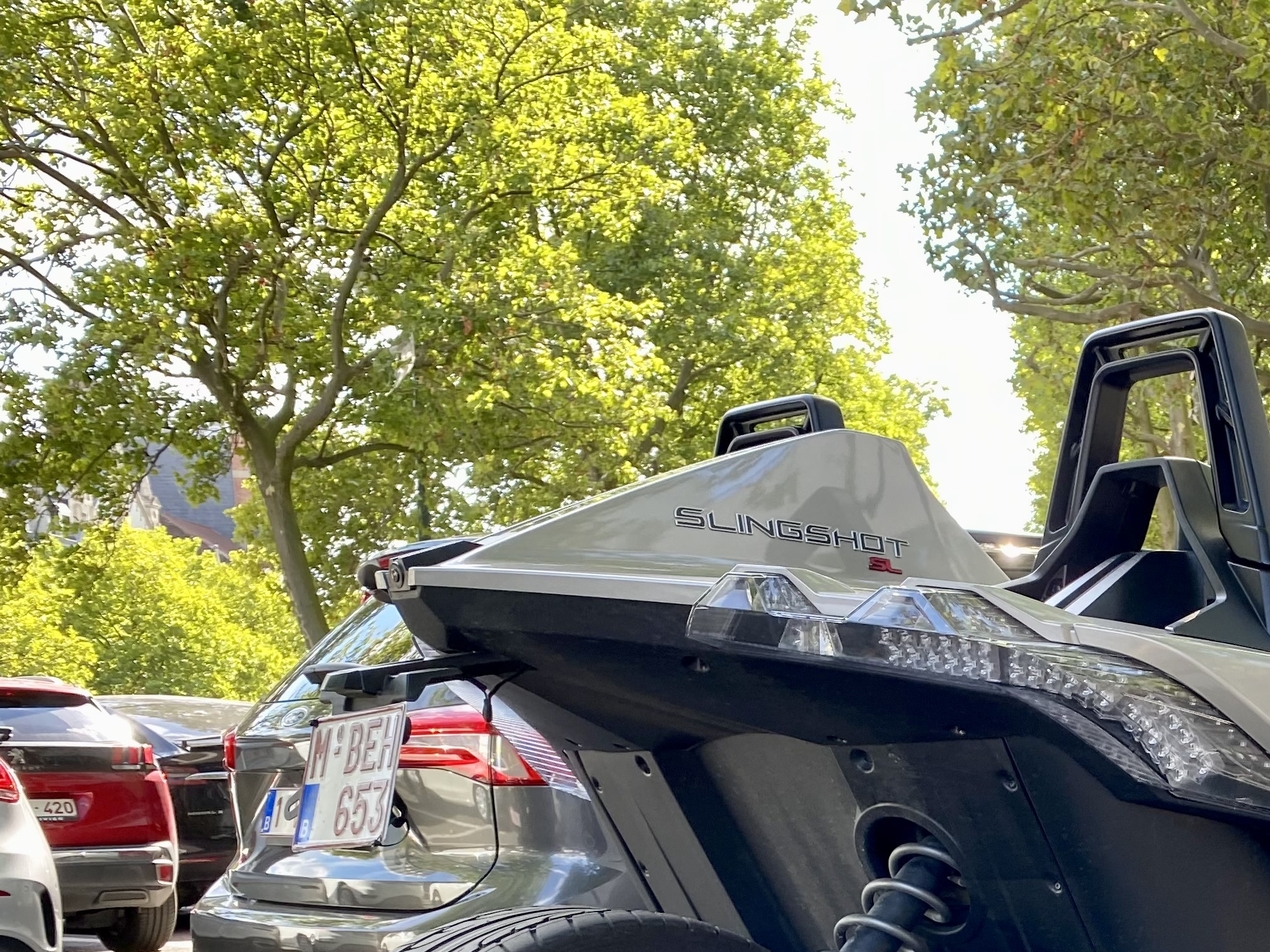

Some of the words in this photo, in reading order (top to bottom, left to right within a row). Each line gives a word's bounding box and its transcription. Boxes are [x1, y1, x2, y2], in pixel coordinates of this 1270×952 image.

[674, 505, 910, 558] SLINGSHOT
[867, 555, 903, 575] SL
[333, 778, 389, 837] 653
[301, 819, 309, 838] B
